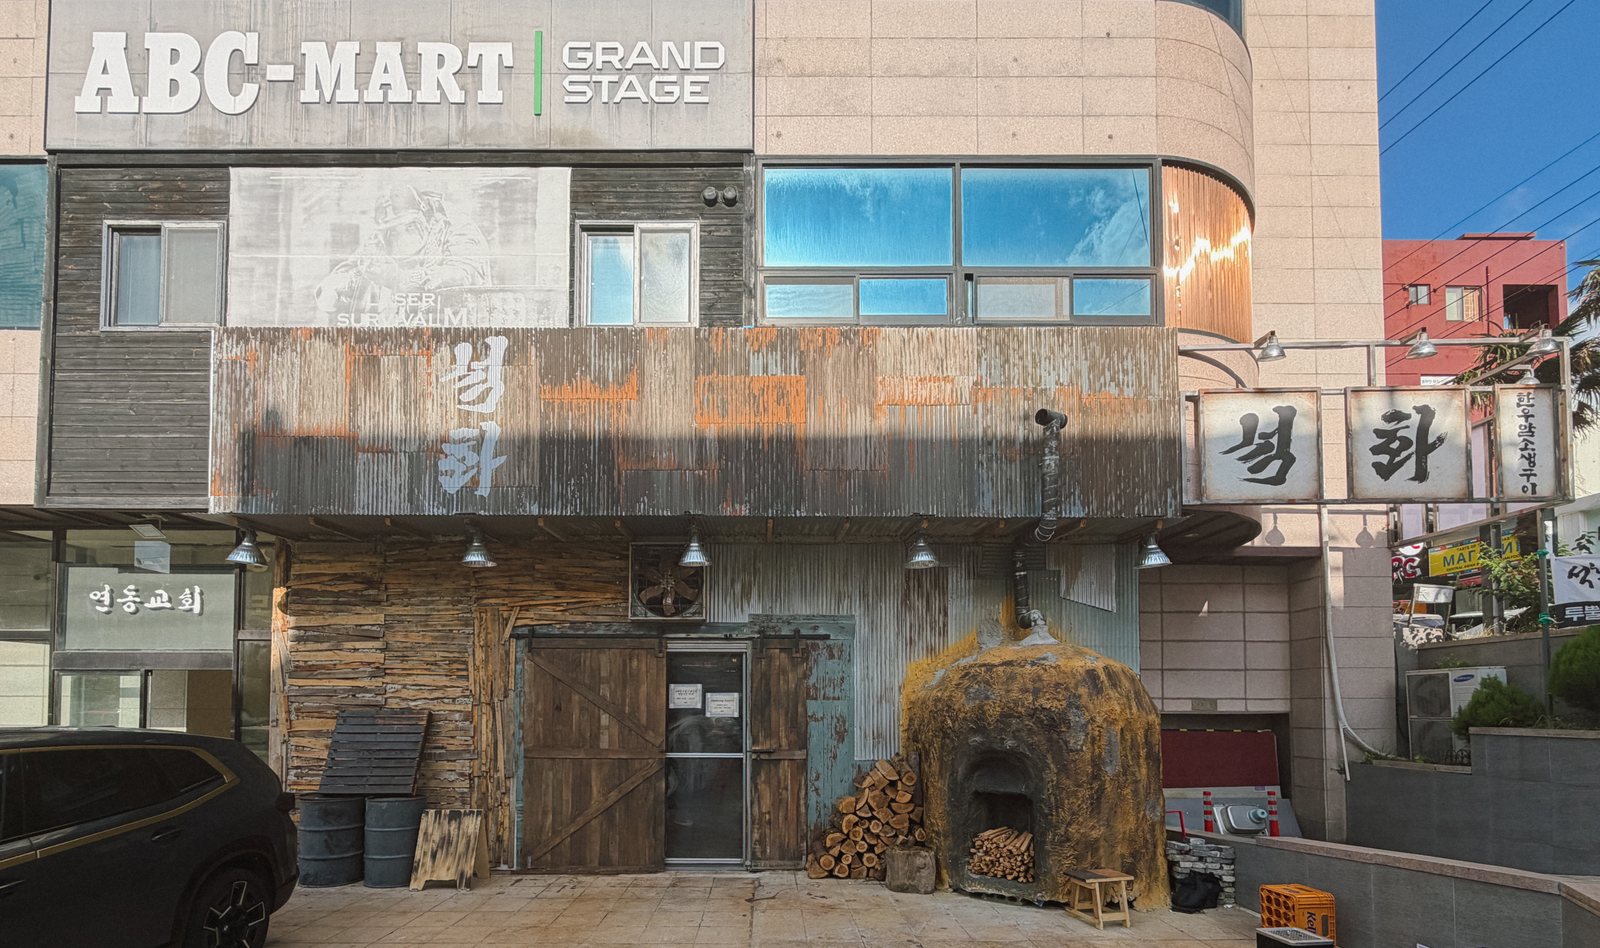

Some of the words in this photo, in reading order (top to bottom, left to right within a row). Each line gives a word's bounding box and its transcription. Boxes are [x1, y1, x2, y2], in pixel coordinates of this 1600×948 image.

[562, 41, 725, 70] GRAND
[74, 31, 514, 115] ABC-MART
[562, 75, 710, 104] STAGE
[89, 584, 202, 614] 연동교회
